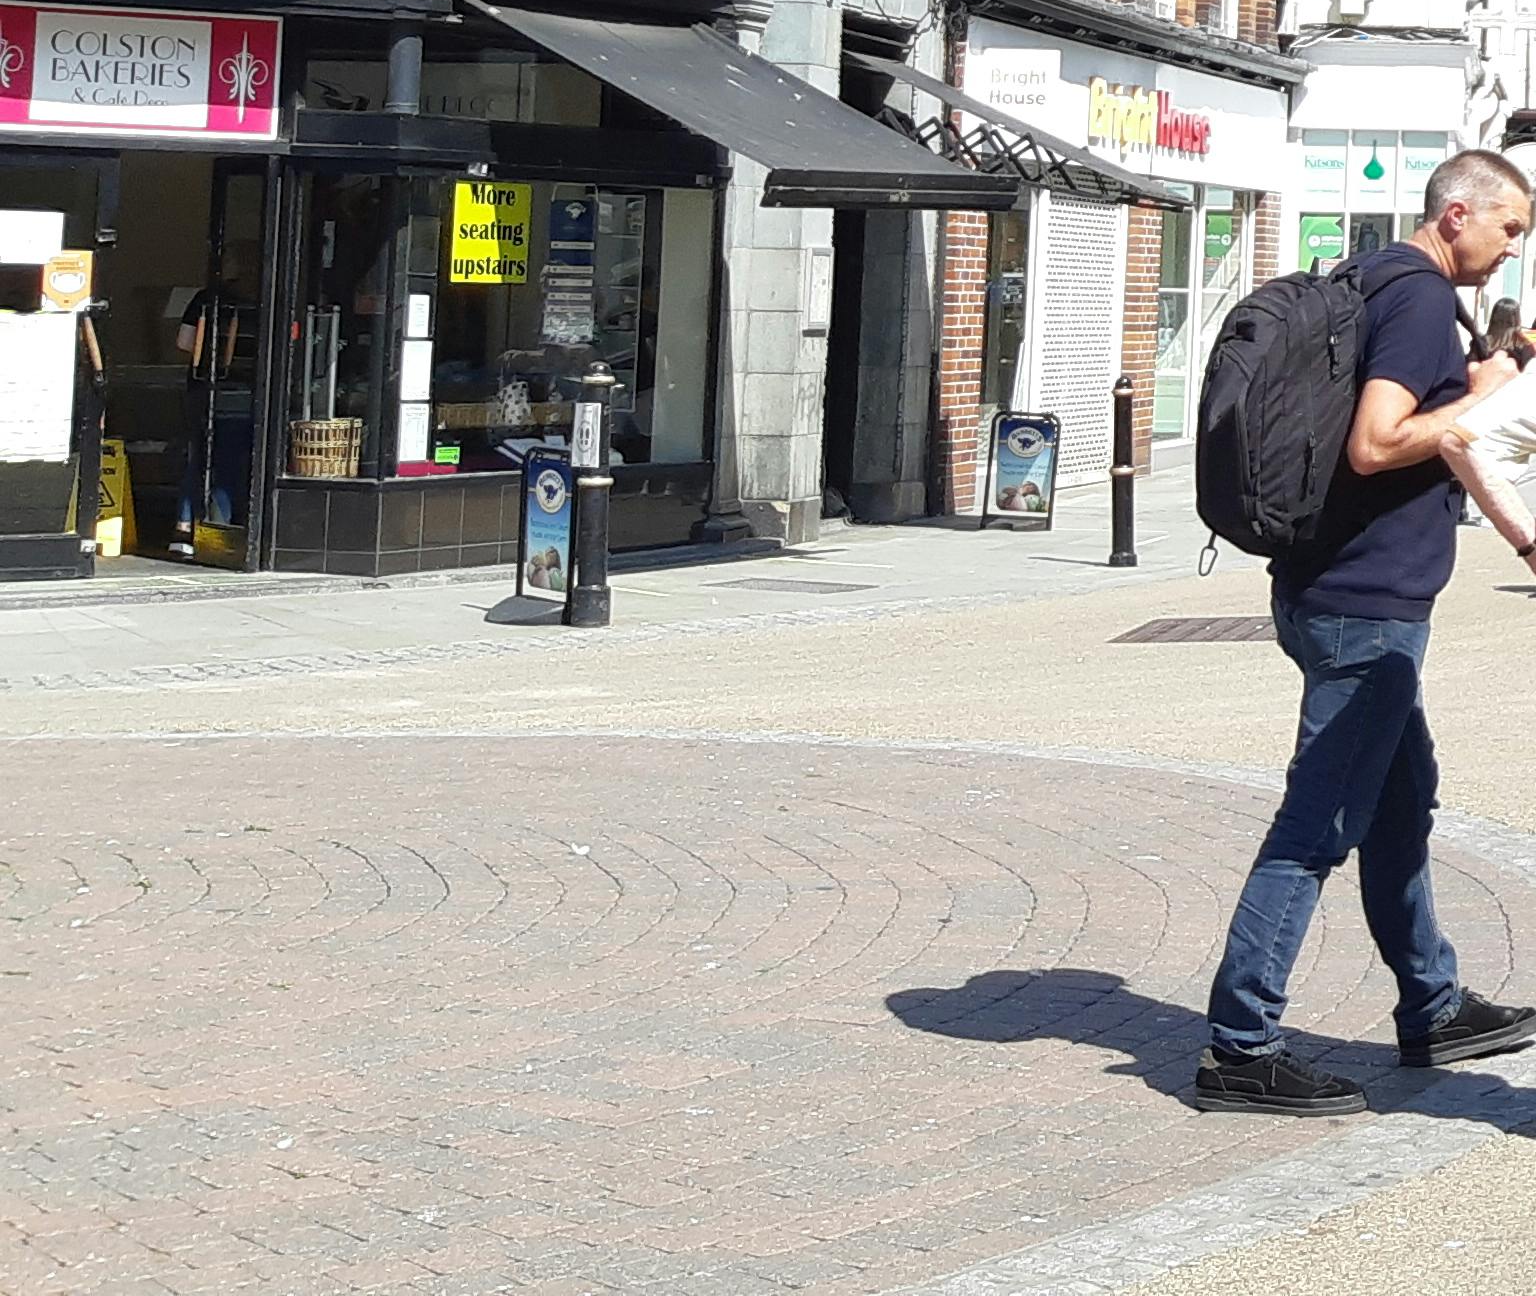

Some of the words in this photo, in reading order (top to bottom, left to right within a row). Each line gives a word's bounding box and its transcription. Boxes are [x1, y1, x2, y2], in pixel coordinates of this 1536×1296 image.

[51, 29, 196, 62] COLSTON
[51, 57, 191, 89] BAKERIES
[990, 67, 1047, 86] Bright
[72, 86, 86, 103] &
[988, 90, 1046, 106] House
[1304, 155, 1345, 170] Kitsons
[471, 184, 516, 206] More
[459, 220, 524, 246] seating
[453, 255, 526, 280] upstairs
